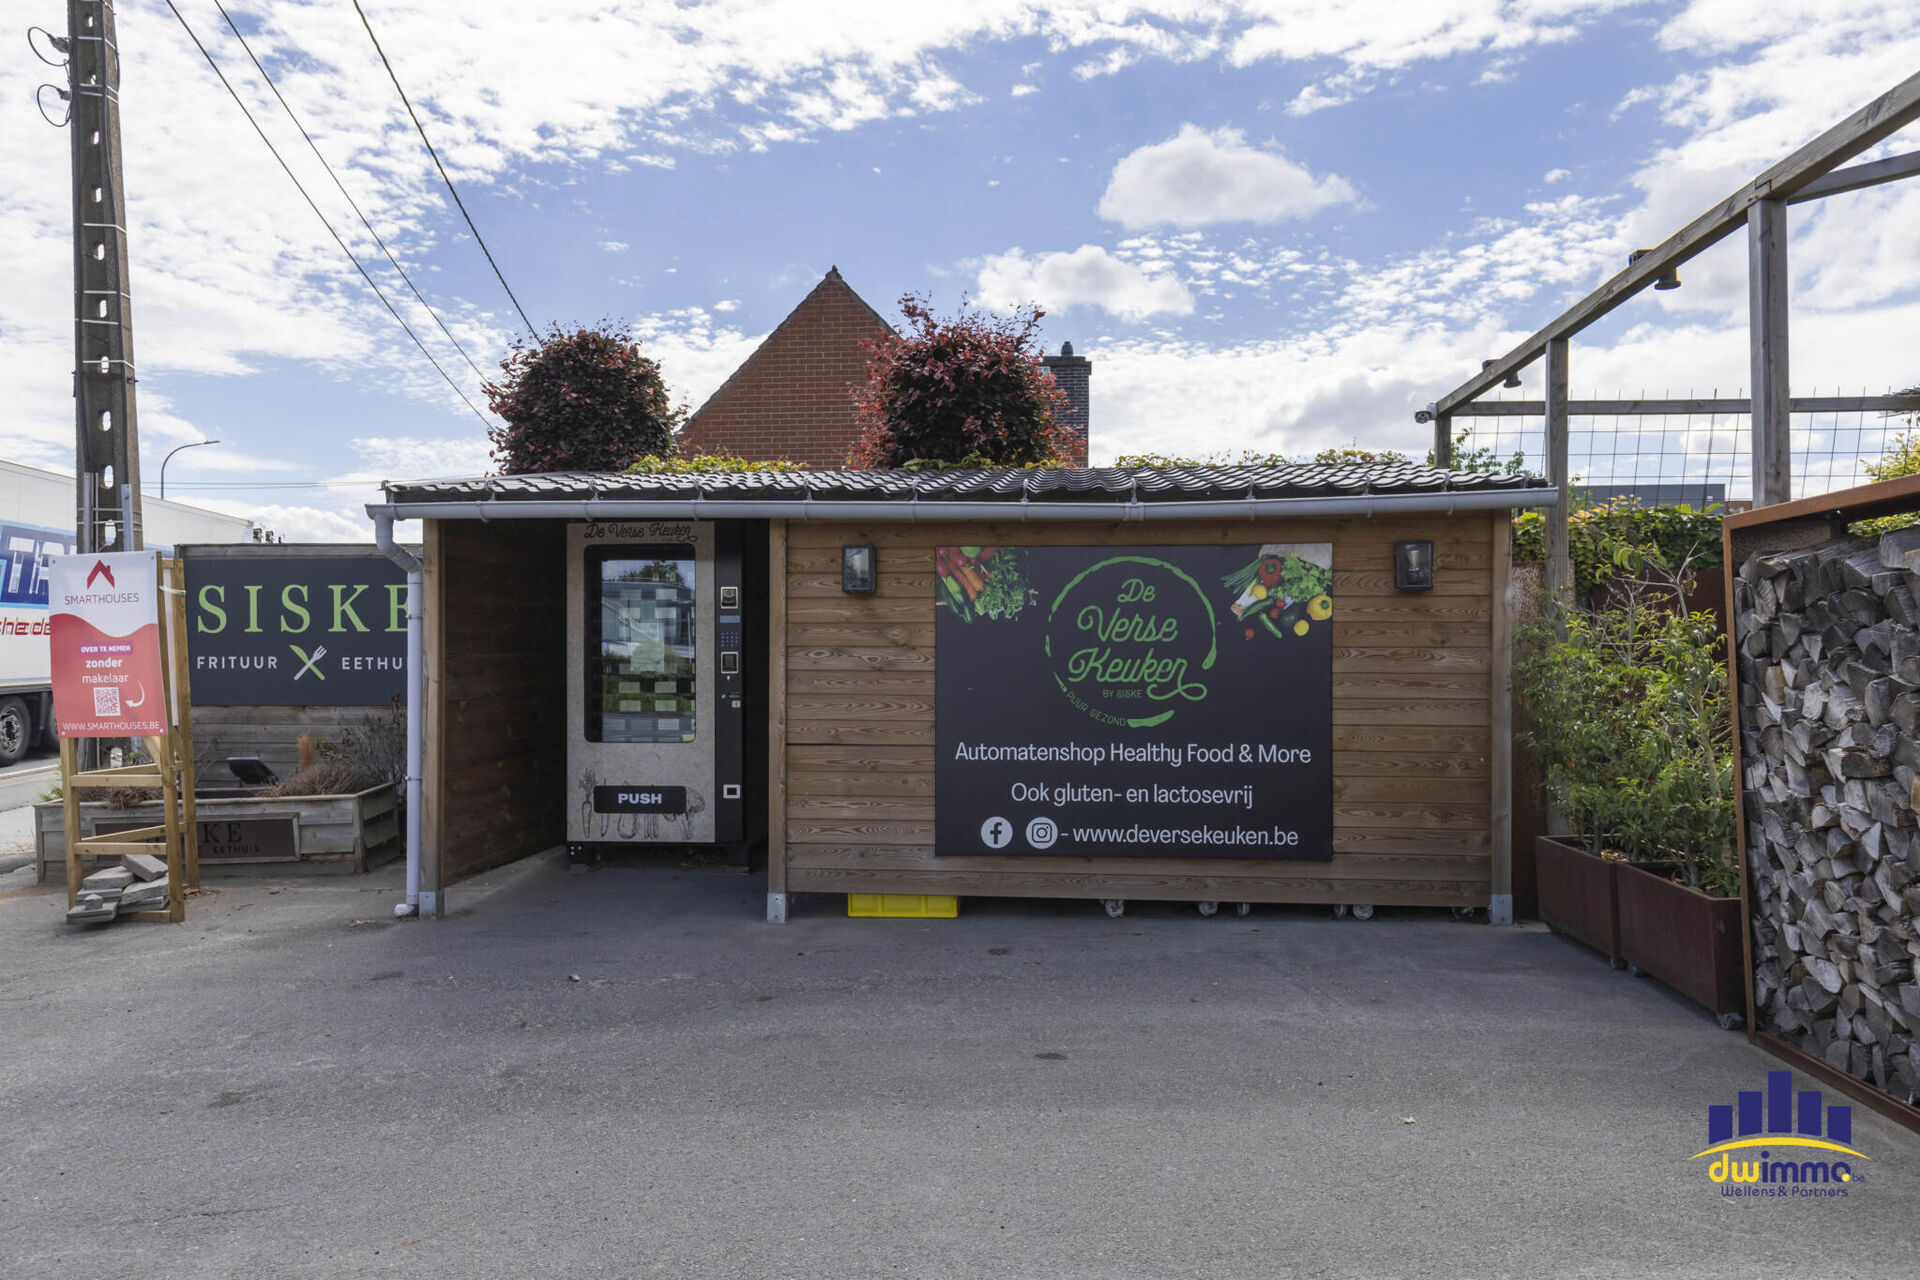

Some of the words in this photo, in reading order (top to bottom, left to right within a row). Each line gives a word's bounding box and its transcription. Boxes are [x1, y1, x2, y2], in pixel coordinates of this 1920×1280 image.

[64, 592, 140, 605] SMARTHOUSES
[1117, 578, 1155, 602] De
[197, 584, 409, 634] SISKE
[1076, 605, 1179, 642] Verse
[80, 645, 99, 653] OVER
[86, 656, 123, 668] zonder
[197, 656, 278, 669] FRITUUR
[341, 656, 408, 670] EETHU
[82, 673, 129, 684] makelaar
[1067, 647, 1208, 701] Keuken
[1067, 691, 1089, 712] PUUR
[1089, 708, 1127, 727] GEZOND
[62, 721, 160, 731] WWW.SMARTHOUSES.BE
[955, 742, 1106, 765] Automatenshop
[1110, 742, 1182, 767] Healthy
[1187, 743, 1234, 762] Food
[1238, 743, 1253, 763] &
[1258, 744, 1312, 763] More
[617, 792, 663, 805] PUSH
[1011, 782, 1050, 801] Ook
[1053, 782, 1122, 807] gluten-
[1126, 788, 1149, 803] en
[1153, 783, 1253, 809] lactosevrij
[1073, 823, 1299, 846] www.deversekeuken.be
